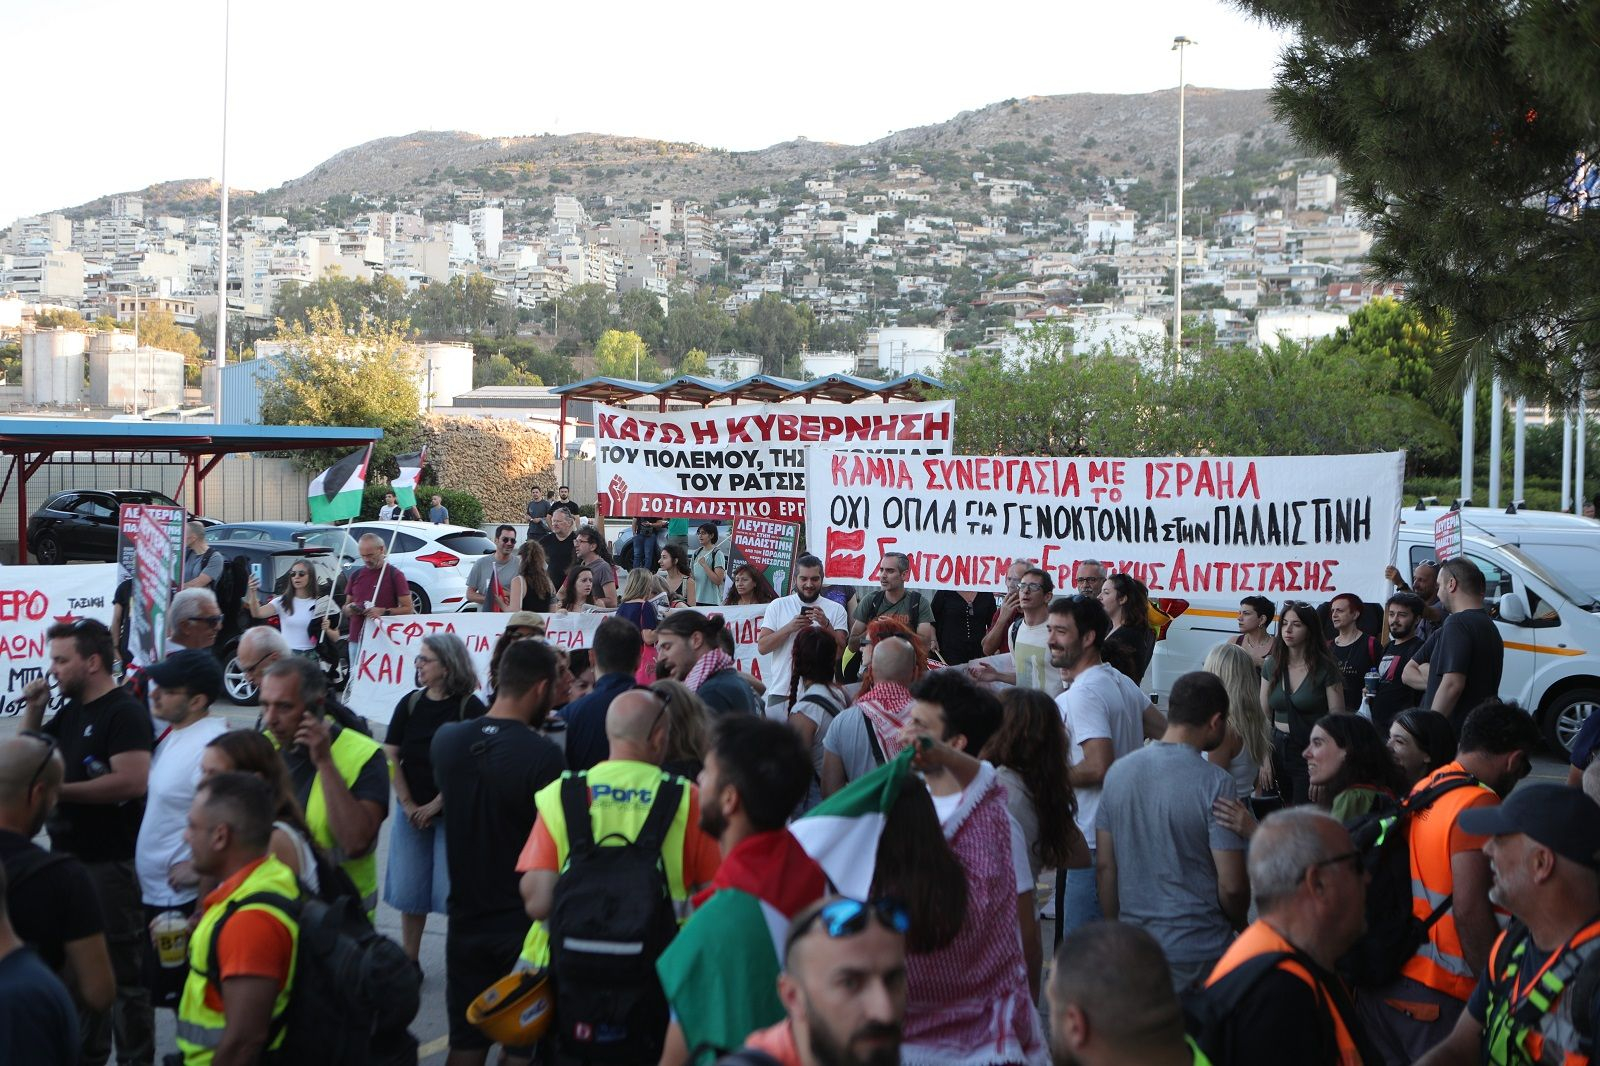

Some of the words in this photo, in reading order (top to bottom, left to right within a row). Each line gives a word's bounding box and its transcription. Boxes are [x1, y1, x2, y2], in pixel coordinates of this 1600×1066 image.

[599, 413, 686, 444] ΚΑΤΩ
[690, 420, 719, 445] Η
[726, 412, 950, 444] ΚΥΒΕΡΝΗΣΗ
[600, 446, 639, 463] ΤΟΥ
[644, 450, 764, 471] ΠΟΛΕΜΟΥ,
[676, 473, 723, 491] ΤΟΥ
[832, 454, 913, 490] ΚΑΜΙΑ
[923, 459, 1080, 497] ΣΥΝΕΡΓΑΣΙΑ
[1088, 461, 1126, 485] ΜΕ
[1145, 460, 1261, 500] ΙΣΡΑΗΛ
[641, 497, 771, 517] ΣΟΣΙΑΛΙΣΤΙΚΟ
[1091, 487, 1123, 503] ΤΟ
[124, 507, 182, 520] ΛΕΤΕΡΙΑ
[830, 495, 870, 529] ΟΧΙ
[883, 497, 957, 534] ΟΠΛΑ
[965, 501, 998, 517] ΓΙΑ
[737, 519, 794, 536] ΛΕΥΤΕΡΙΑ
[966, 522, 993, 535] ΤΗ
[1003, 503, 1159, 544] ΓΕΝΟΚΤΟΝΙΑ
[735, 535, 792, 551] ΠΑΛΑΙΣΤΙΝΗ
[1169, 548, 1339, 592] ΑΝΤΙΣΤΑΣΗΣ
[358, 650, 403, 684] ΚΑΙ
[592, 785, 652, 803] Port
